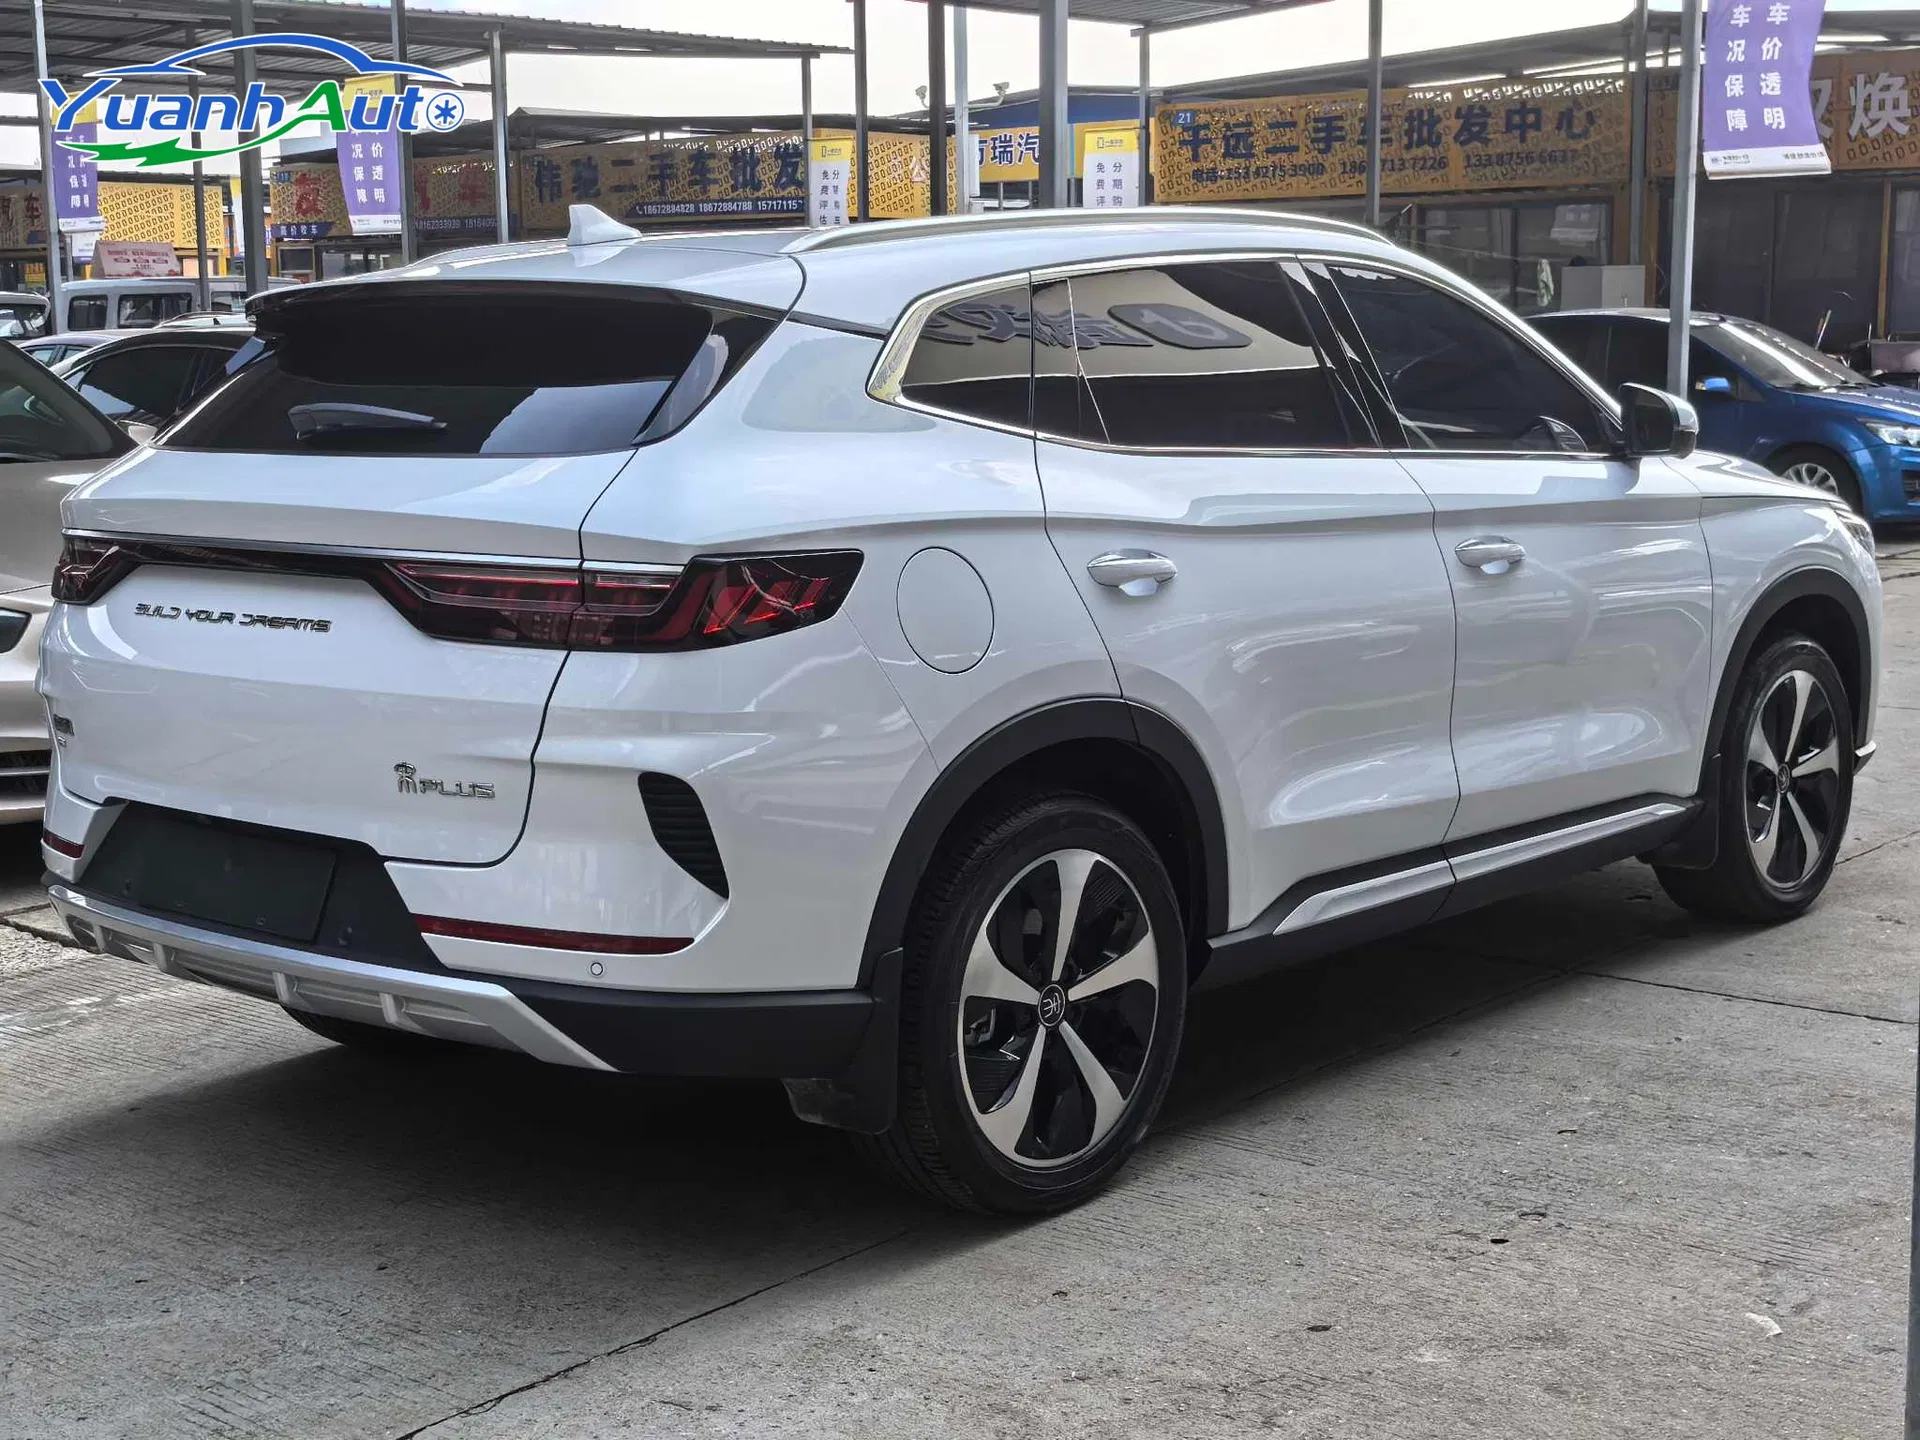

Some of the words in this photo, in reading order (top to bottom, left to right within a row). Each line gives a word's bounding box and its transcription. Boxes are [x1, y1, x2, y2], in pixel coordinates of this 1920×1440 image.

[1724, 4, 1752, 132] 车况保障
[1759, 2, 1791, 130] 车价透明
[1177, 112, 1192, 125] 21
[133, 602, 182, 620] BUILD
[185, 607, 237, 625] YOUR
[238, 612, 333, 634] DREAMS
[419, 777, 496, 799] PLUS
